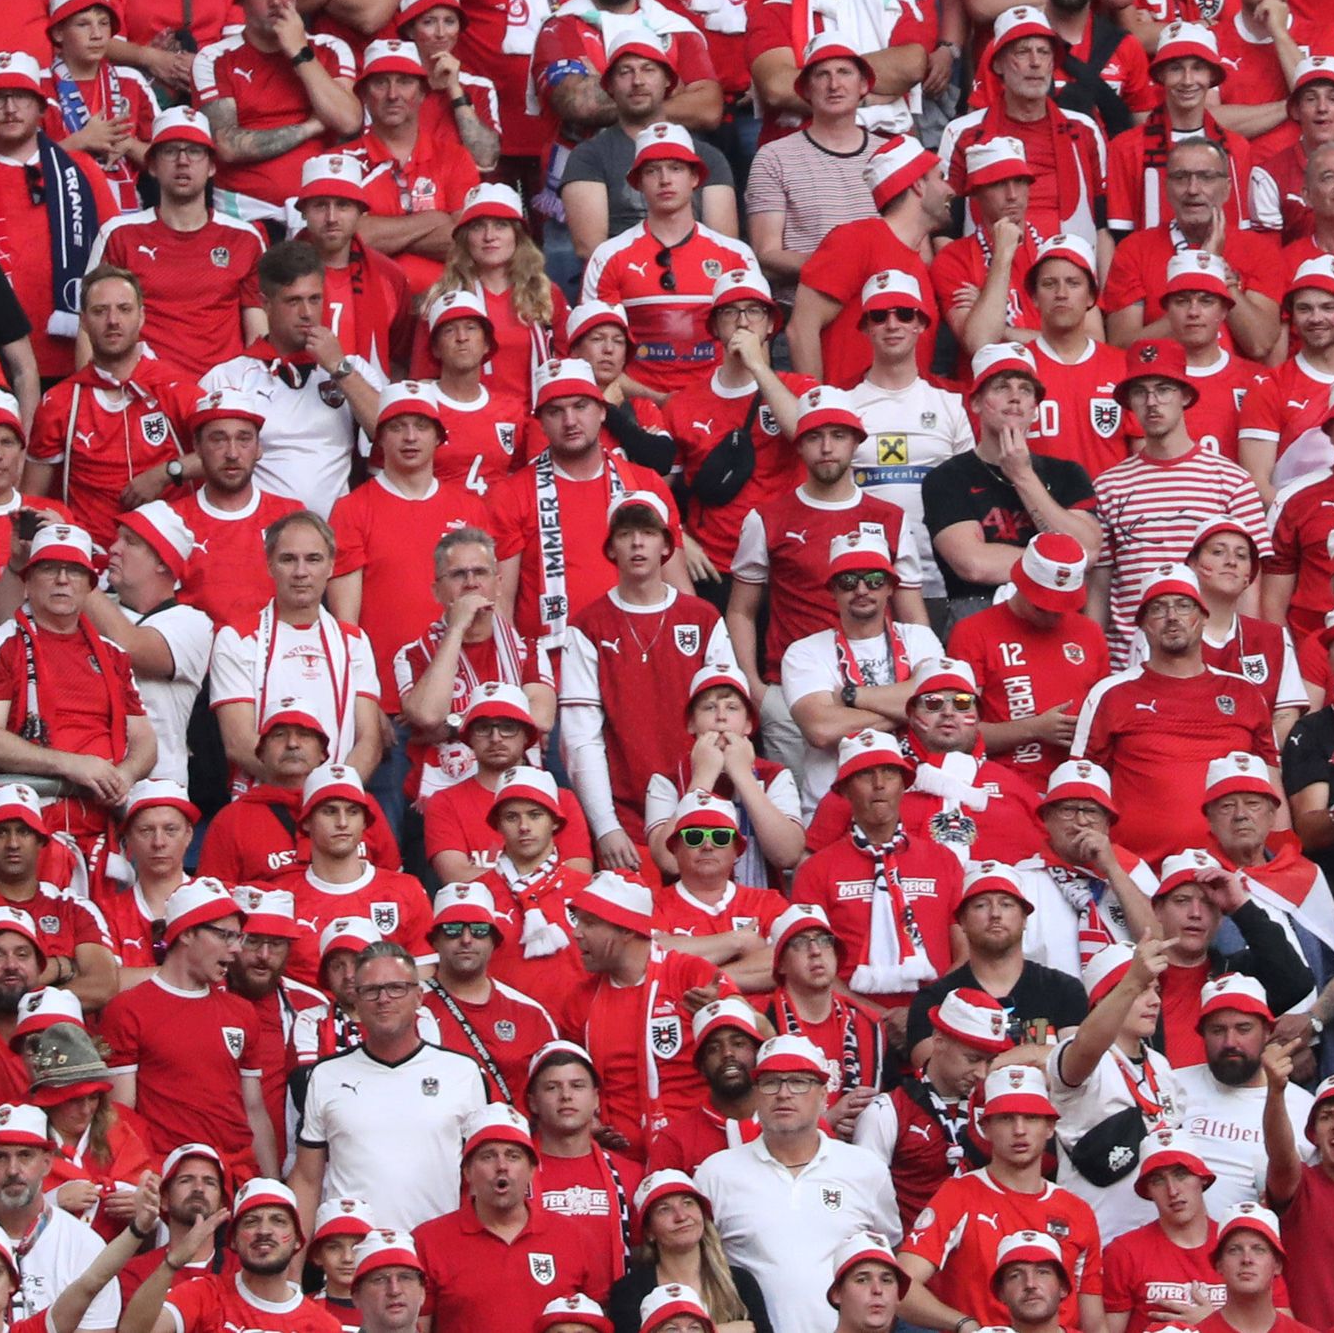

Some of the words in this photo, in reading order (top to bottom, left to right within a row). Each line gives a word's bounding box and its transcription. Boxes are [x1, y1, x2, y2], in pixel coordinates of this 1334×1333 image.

[65, 166, 83, 247] FRANCE
[465, 453, 488, 496] 4
[540, 492, 566, 578] IMMER
[999, 642, 1027, 667] 12
[1003, 675, 1043, 764] ÖSREICH
[1189, 1117, 1261, 1144] Althei
